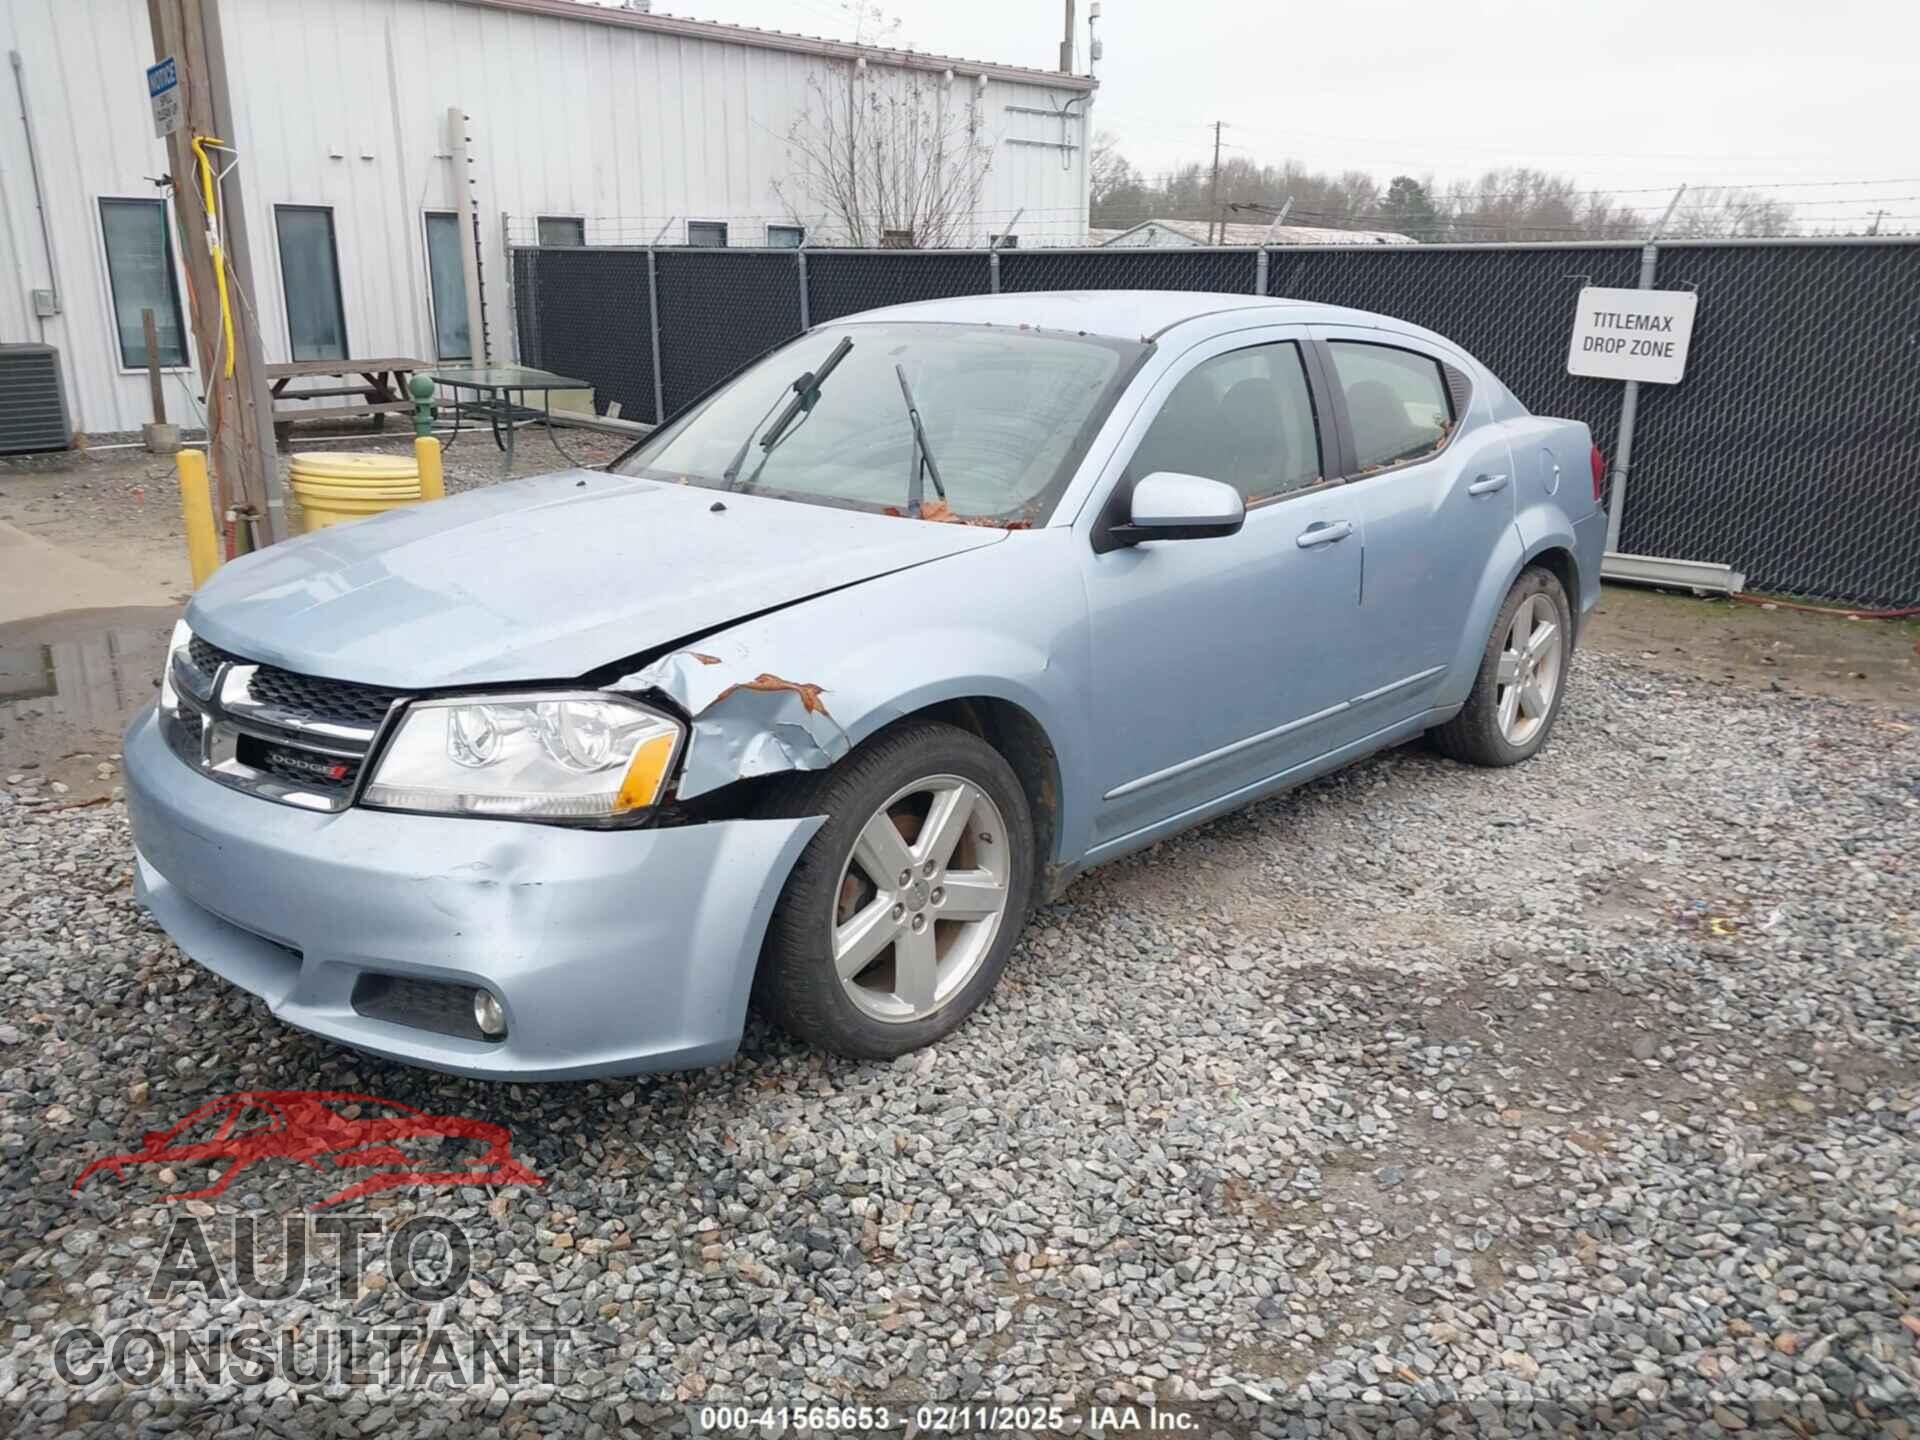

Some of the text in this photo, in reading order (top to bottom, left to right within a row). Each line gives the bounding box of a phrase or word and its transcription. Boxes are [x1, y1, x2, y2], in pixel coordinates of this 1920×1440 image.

[1592, 311, 1675, 332] TITLEMAX
[1583, 335, 1676, 358] DROP ZONE
